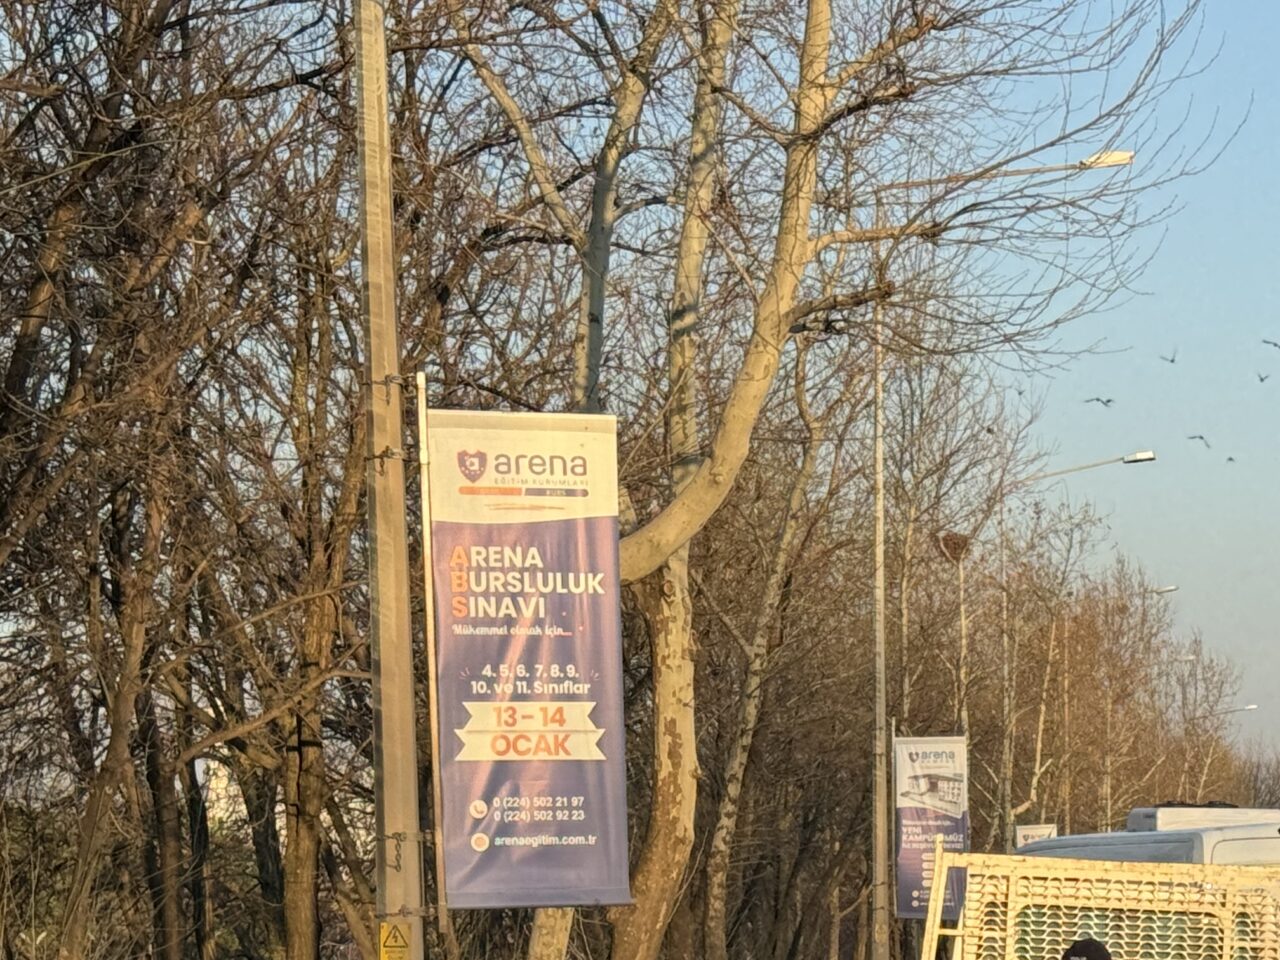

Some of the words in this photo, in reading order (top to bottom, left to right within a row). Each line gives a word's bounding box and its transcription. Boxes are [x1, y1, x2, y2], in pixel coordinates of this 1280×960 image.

[494, 453, 588, 477] arena
[449, 546, 544, 569] ARENA
[450, 571, 606, 594] BURSLULUK
[451, 596, 546, 619] SINAVI
[452, 623, 508, 635] Mükemmel
[510, 624, 542, 635] olmak
[481, 663, 497, 677] 4.
[499, 664, 513, 677] 5.
[516, 664, 530, 677] 6.
[534, 664, 548, 677] 7.
[550, 664, 564, 678] 8.
[566, 664, 580, 678] 9.
[470, 681, 491, 694] 10.
[493, 683, 514, 694] ve
[516, 681, 531, 694] 11.
[533, 680, 591, 695] Sınıflar
[493, 706, 518, 728] 13
[539, 706, 566, 728] 14
[490, 733, 572, 757] OCAK
[920, 751, 956, 760] arena
[493, 797, 501, 808] 0
[503, 796, 531, 809] (224)
[533, 796, 553, 807] 502
[555, 796, 568, 807] 21
[571, 796, 585, 807] 97
[493, 811, 501, 821] 0
[503, 810, 531, 823] (224)
[533, 810, 553, 821] 502
[555, 810, 569, 821] 92
[571, 810, 585, 821] 23
